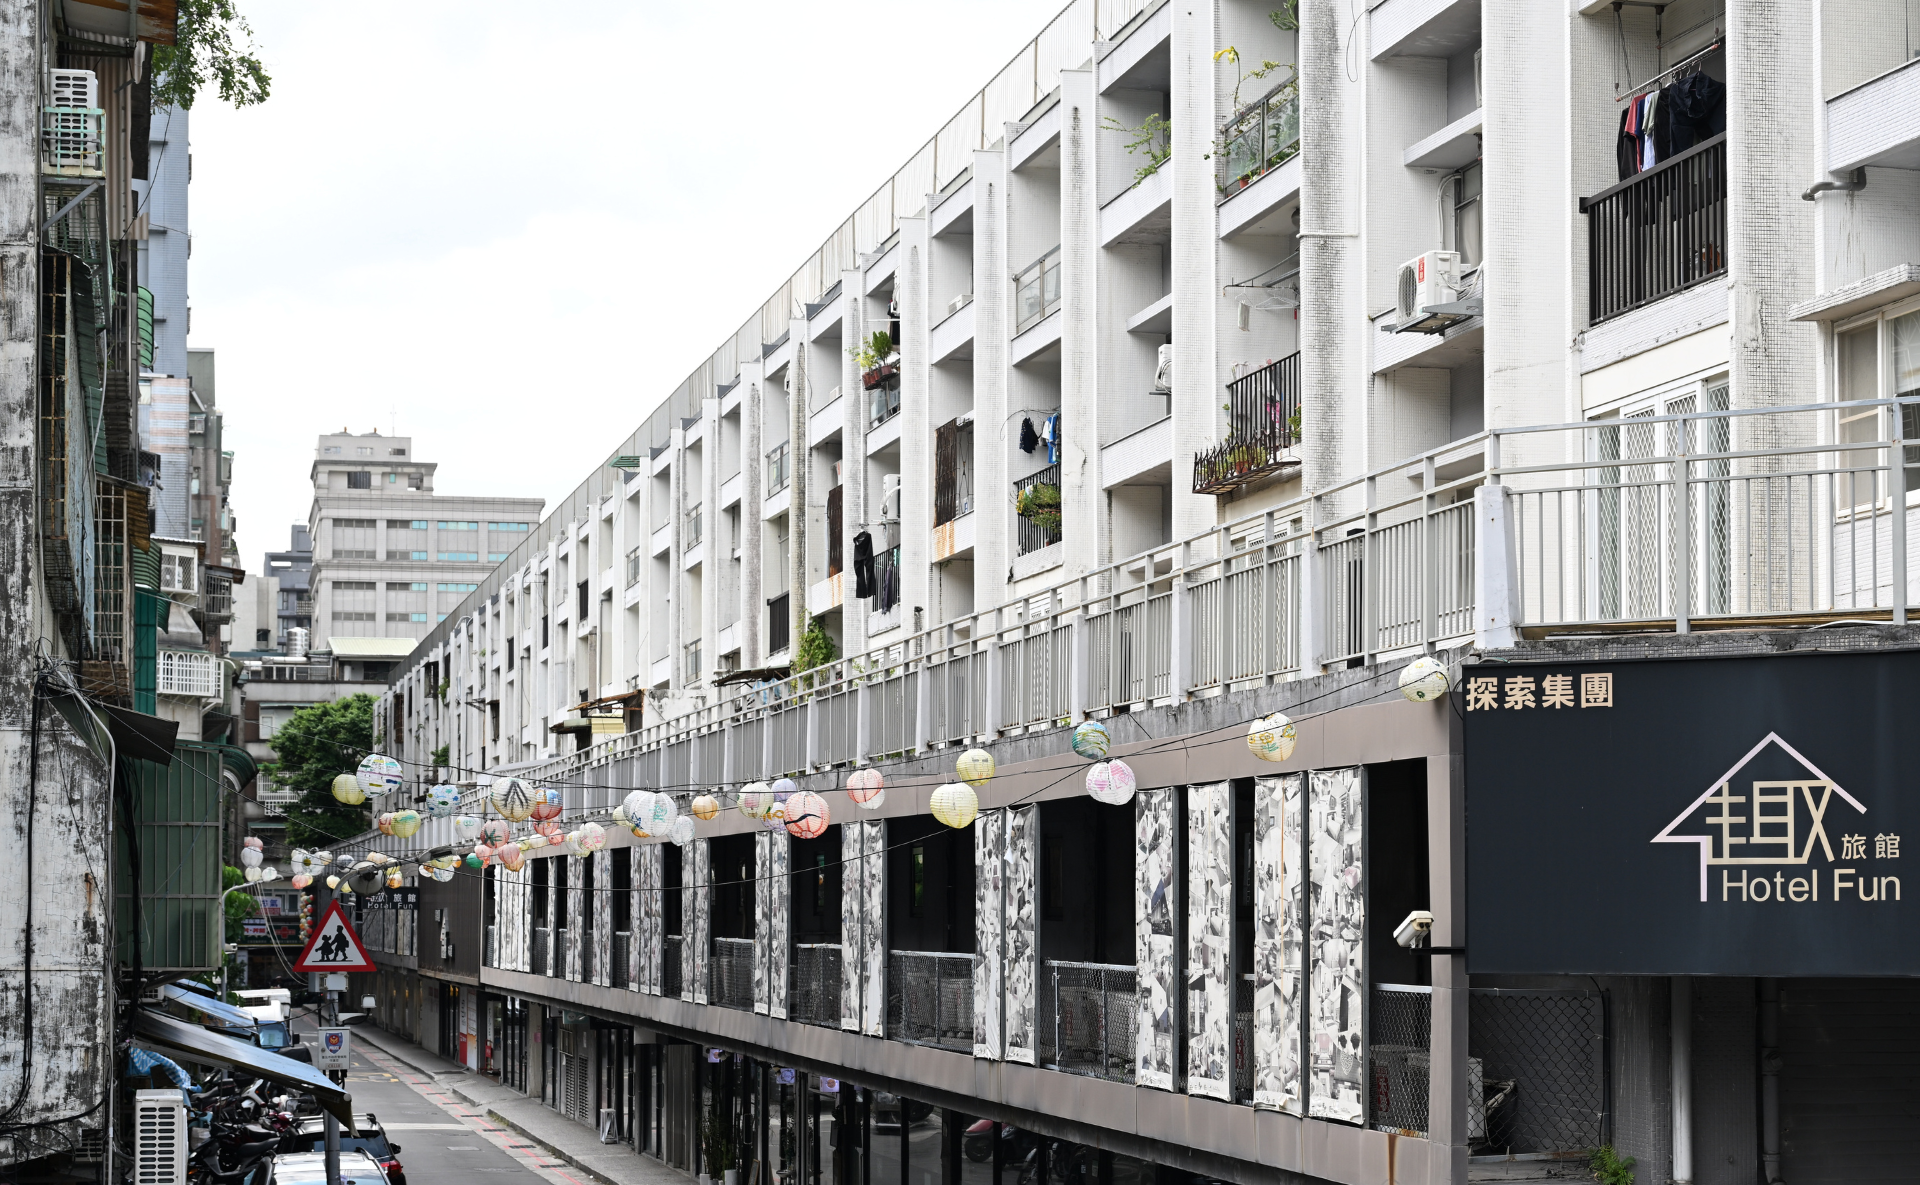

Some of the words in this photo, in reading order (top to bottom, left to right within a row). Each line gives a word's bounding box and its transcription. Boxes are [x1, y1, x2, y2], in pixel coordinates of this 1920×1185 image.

[1466, 672, 1613, 711] 探索集團
[1705, 779, 1835, 865] 趣
[1841, 832, 1901, 860] 旅館
[393, 893, 416, 903] 旅館
[1722, 869, 1818, 902] Hotel
[1833, 868, 1901, 902] Fun
